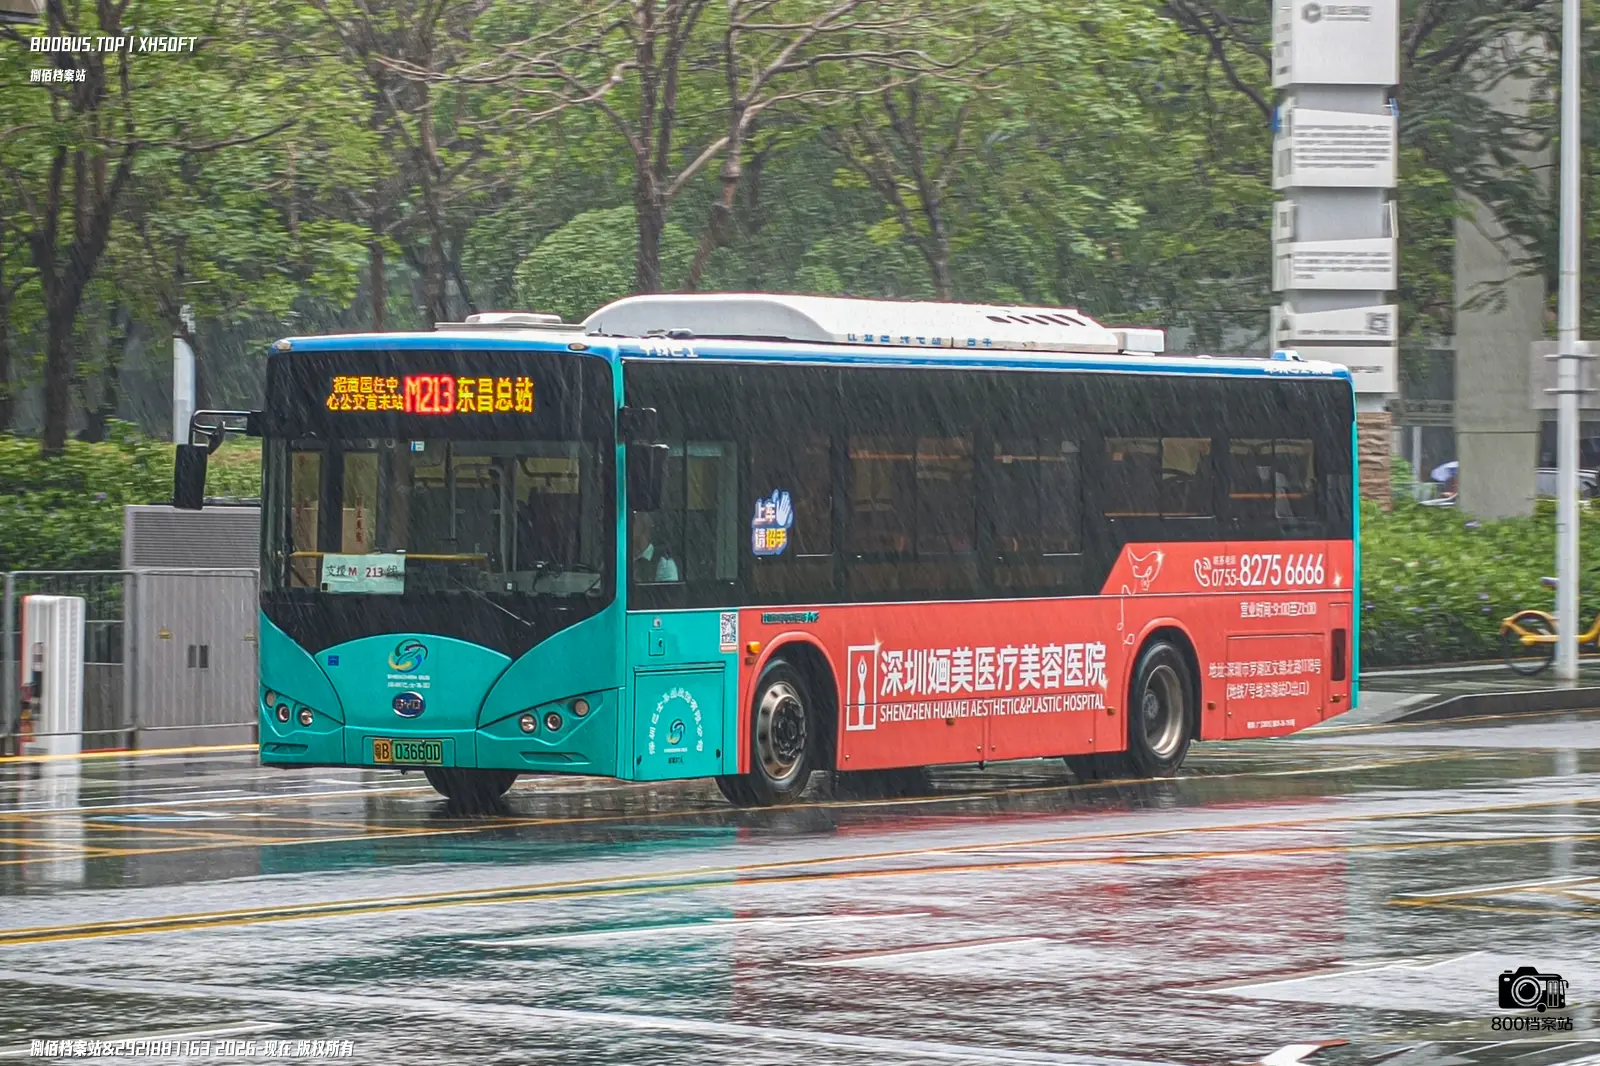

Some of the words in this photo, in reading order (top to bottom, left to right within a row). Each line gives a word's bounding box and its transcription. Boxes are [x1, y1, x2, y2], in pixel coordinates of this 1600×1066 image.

[404, 375, 454, 413] M213
[456, 376, 534, 412] 东昌总站
[1285, 553, 1324, 585] 6666
[880, 641, 1107, 697] 深圳婳美医疗美容医院
[880, 703, 932, 722] SHENZHEN
[933, 701, 970, 720] HUAMEI
[971, 696, 1062, 717] AESTHETIC&PLASTIC
[1063, 693, 1105, 712] HOSPITAL
